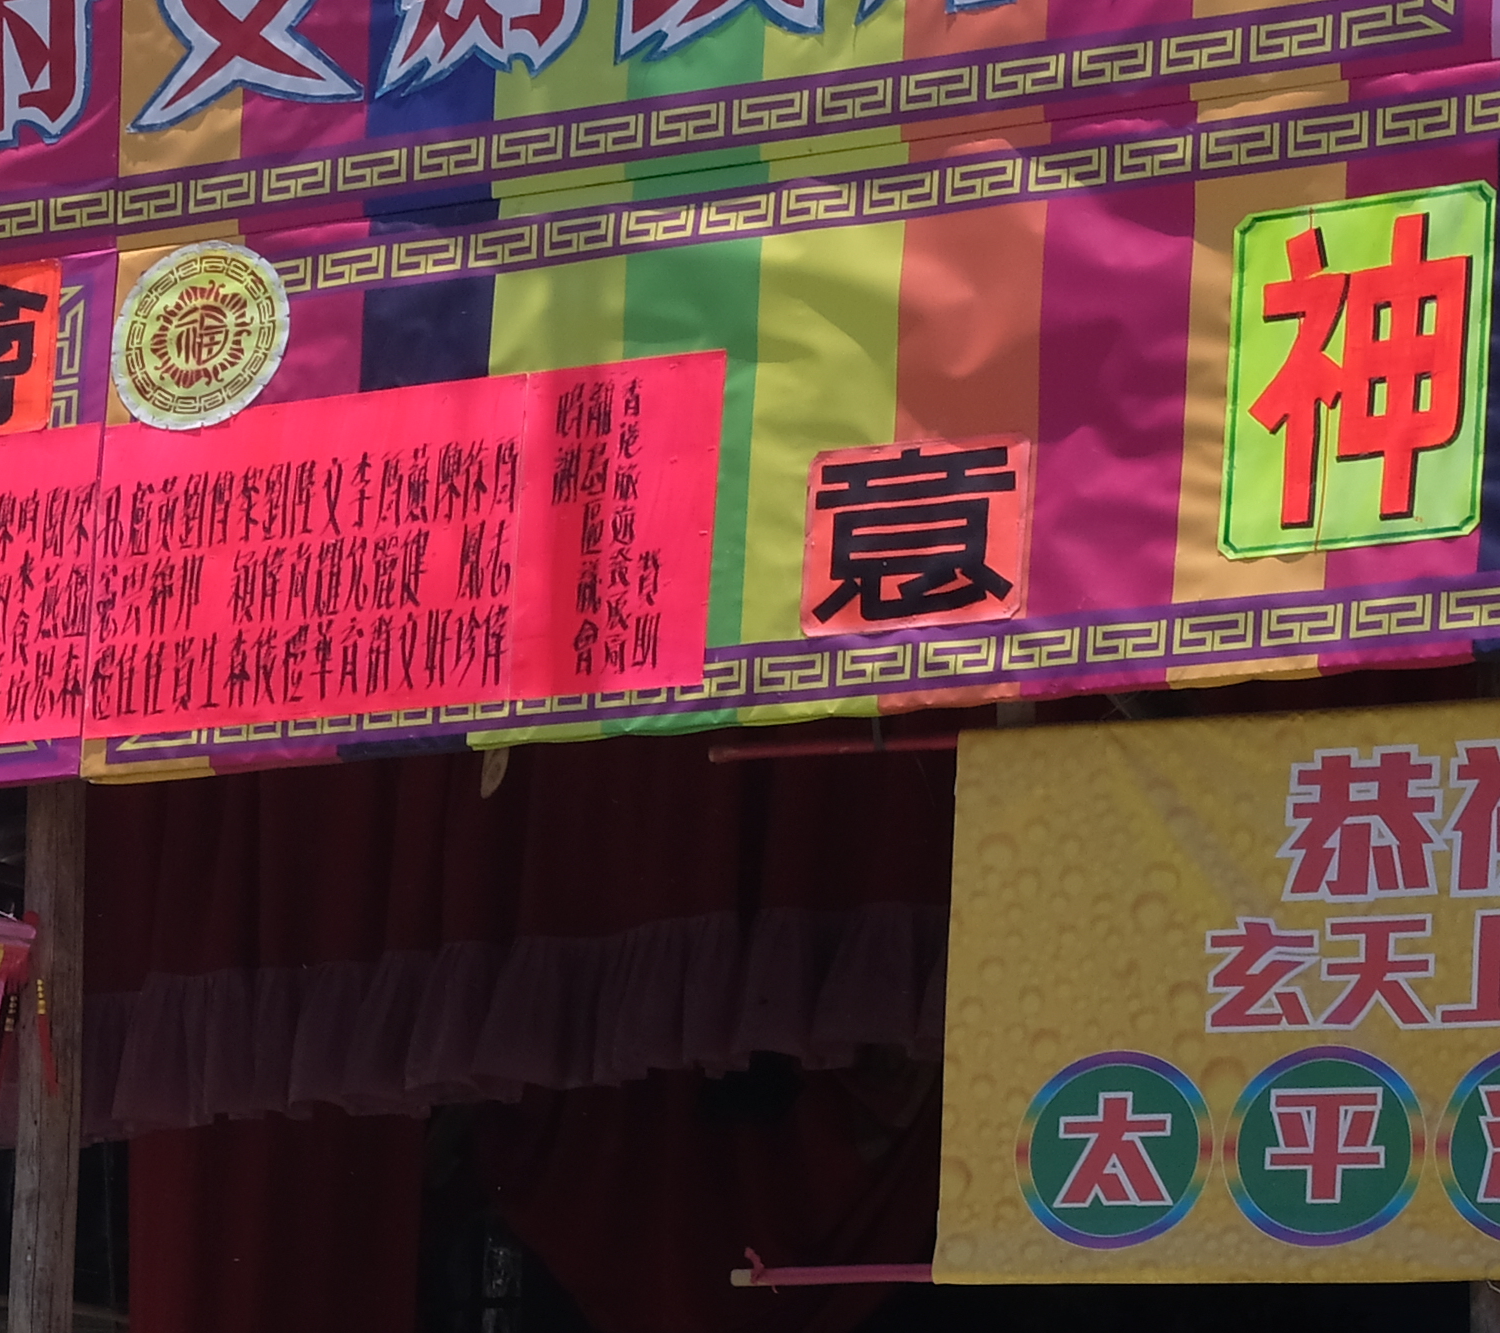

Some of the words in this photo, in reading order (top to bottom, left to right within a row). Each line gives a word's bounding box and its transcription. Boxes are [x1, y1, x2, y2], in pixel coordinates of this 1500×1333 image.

[1250, 212, 1469, 528] 神
[812, 447, 1016, 625] 意
[1054, 1086, 1500, 1208] 太平
